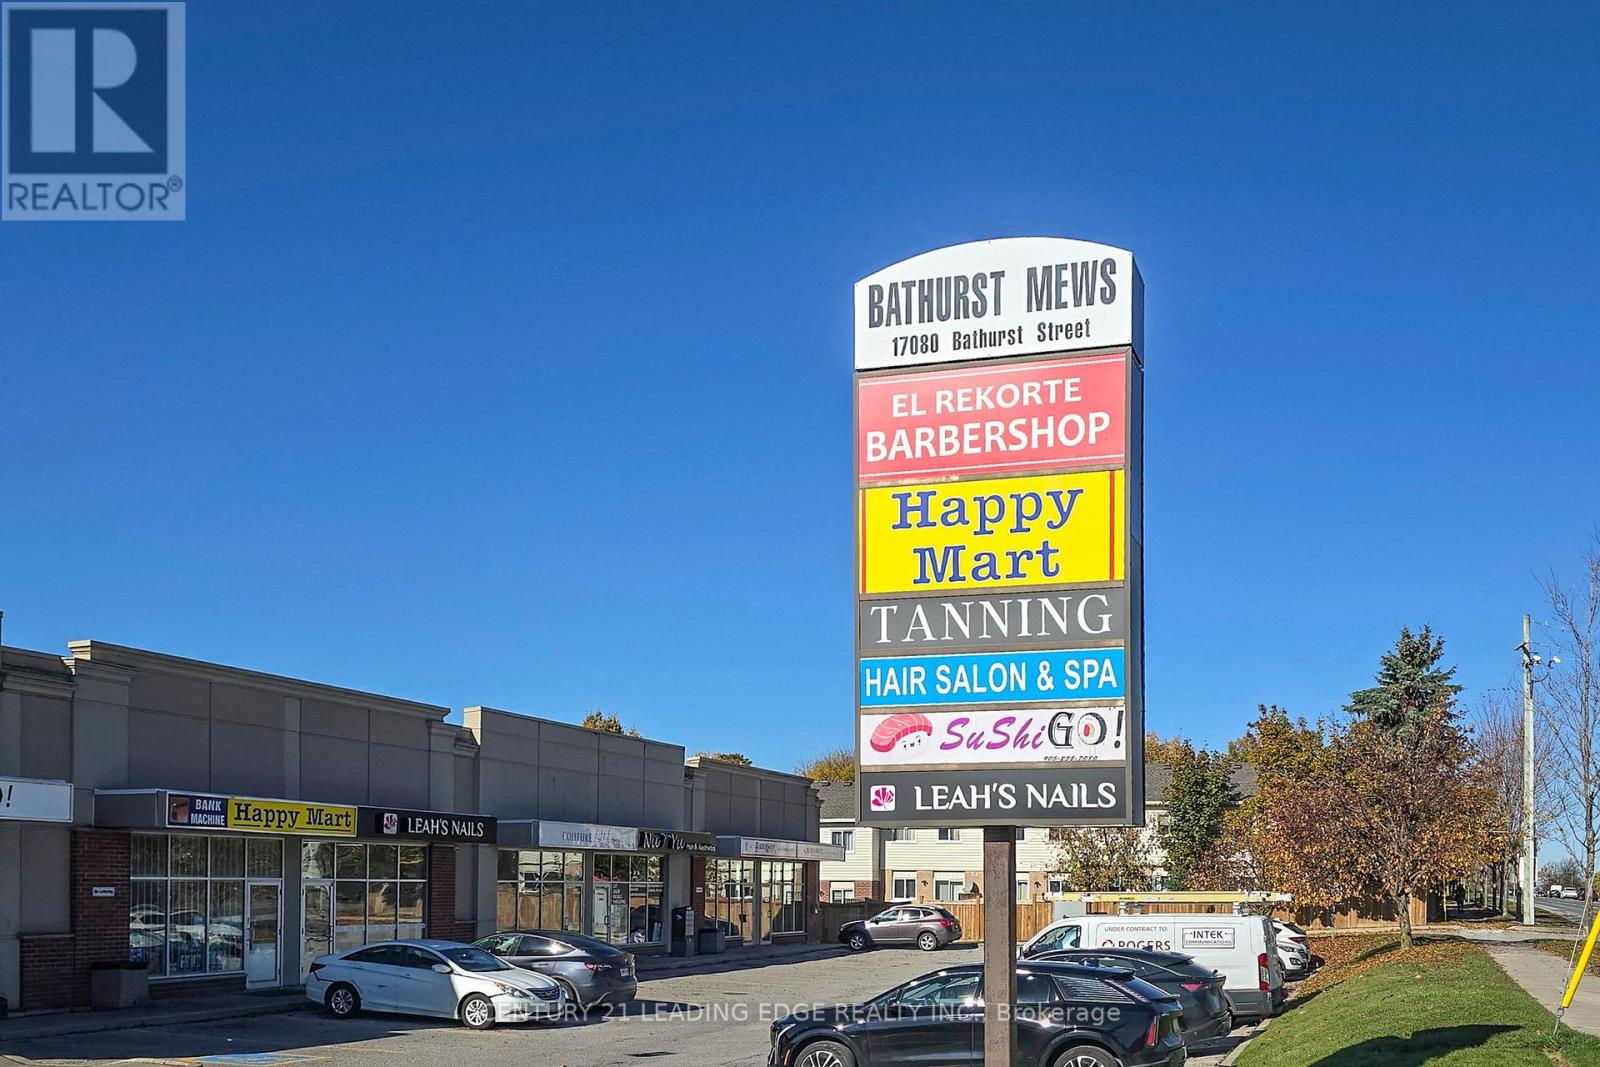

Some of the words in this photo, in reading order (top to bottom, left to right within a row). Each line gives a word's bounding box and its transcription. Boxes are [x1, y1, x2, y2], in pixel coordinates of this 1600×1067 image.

[868, 270, 1006, 329] BATHURST
[1026, 258, 1117, 312] MEWS
[892, 333, 939, 357] 17080
[952, 325, 1023, 351] Bathurst
[1037, 318, 1091, 343] Street
[892, 394, 927, 418] EL
[935, 377, 1082, 415] REKORTE
[866, 411, 1111, 463] BARBERSHOP
[891, 488, 1084, 536] Happy
[912, 540, 1060, 585] Mart
[869, 594, 1113, 644] TANNING
[865, 665, 927, 697] HAIR
[935, 662, 1027, 695] SALON
[1036, 660, 1055, 690] &
[1063, 658, 1118, 690] SPA
[195, 799, 222, 812] BANK
[233, 802, 300, 829] Happy
[305, 807, 351, 828] Mart
[914, 783, 1016, 811] LEAH'S
[1026, 782, 1117, 809] NAILS
[190, 813, 225, 826] MACHINE
[408, 817, 449, 835] LEAH'S
[451, 819, 484, 837] NAILS
[1193, 930, 1224, 939] INTEK
